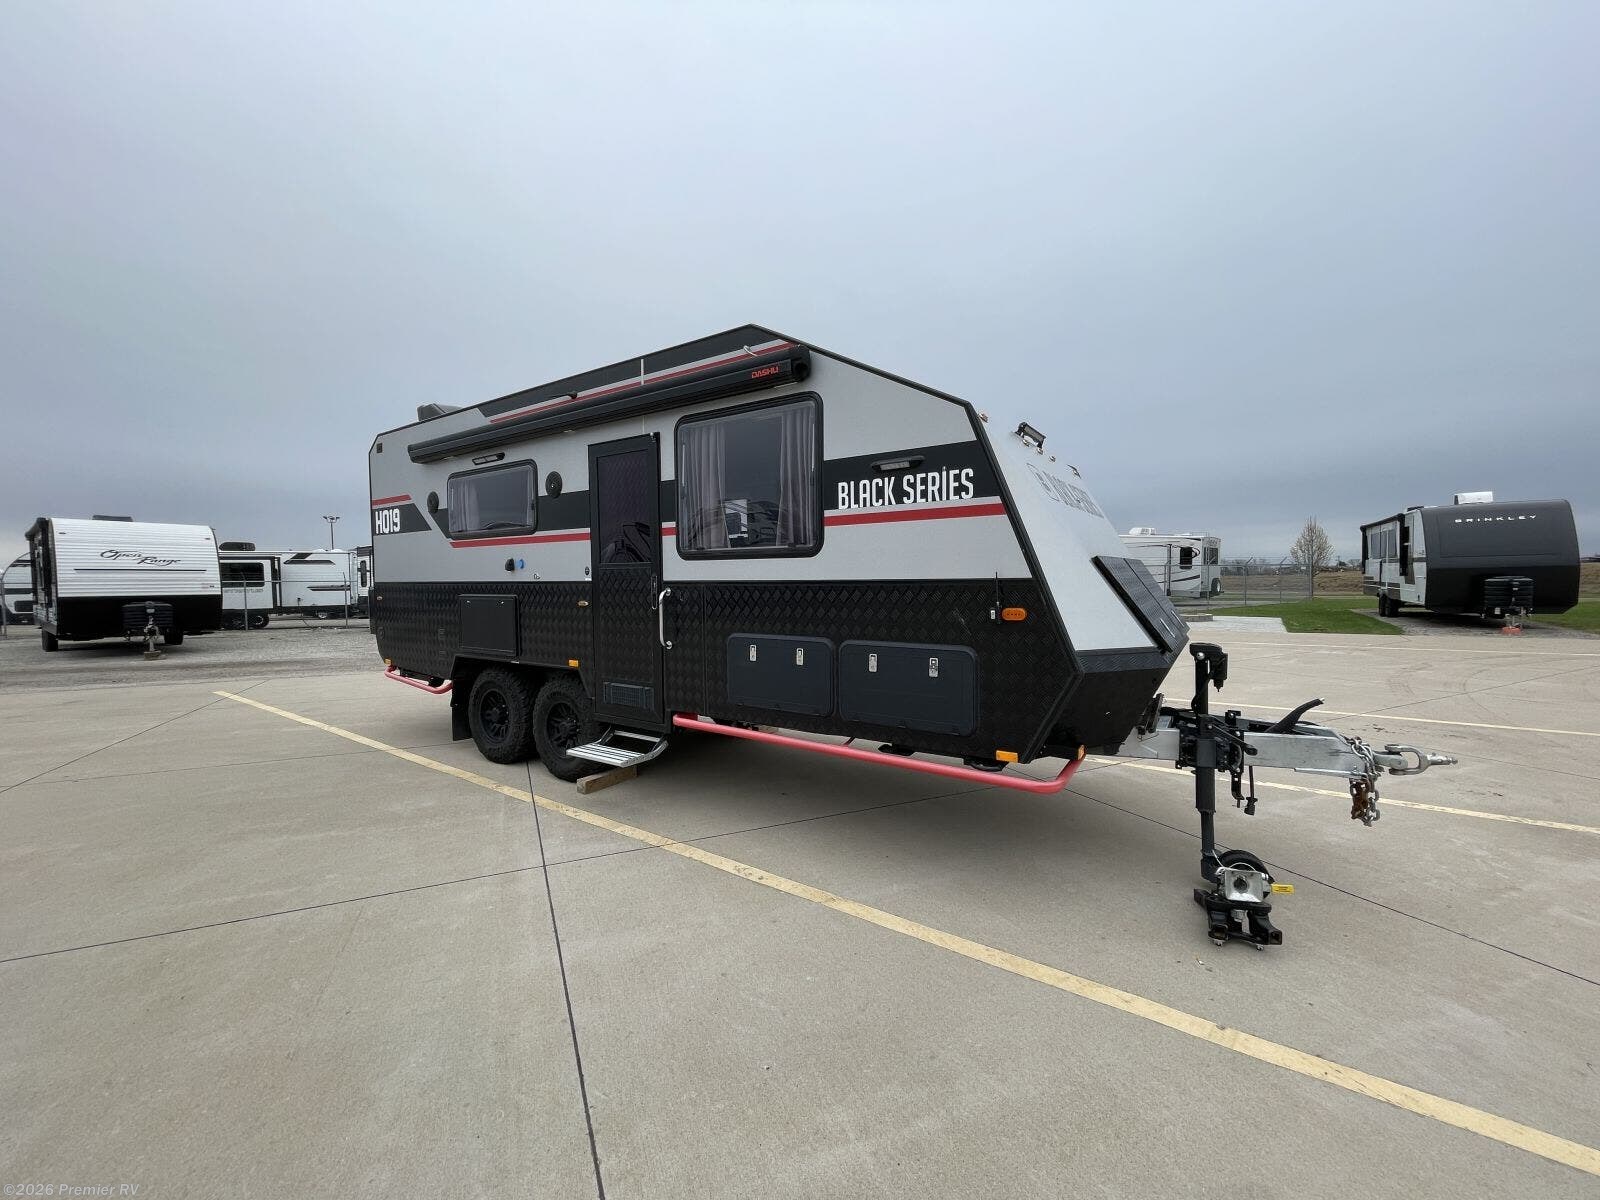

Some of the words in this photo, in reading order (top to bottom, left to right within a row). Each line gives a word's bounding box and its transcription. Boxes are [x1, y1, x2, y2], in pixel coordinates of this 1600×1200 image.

[837, 476, 896, 510] BLACK
[902, 466, 974, 504] SERIES
[1454, 514, 1537, 523] BRINKLEY
[100, 549, 142, 561] Open
[136, 556, 182, 567] Range
